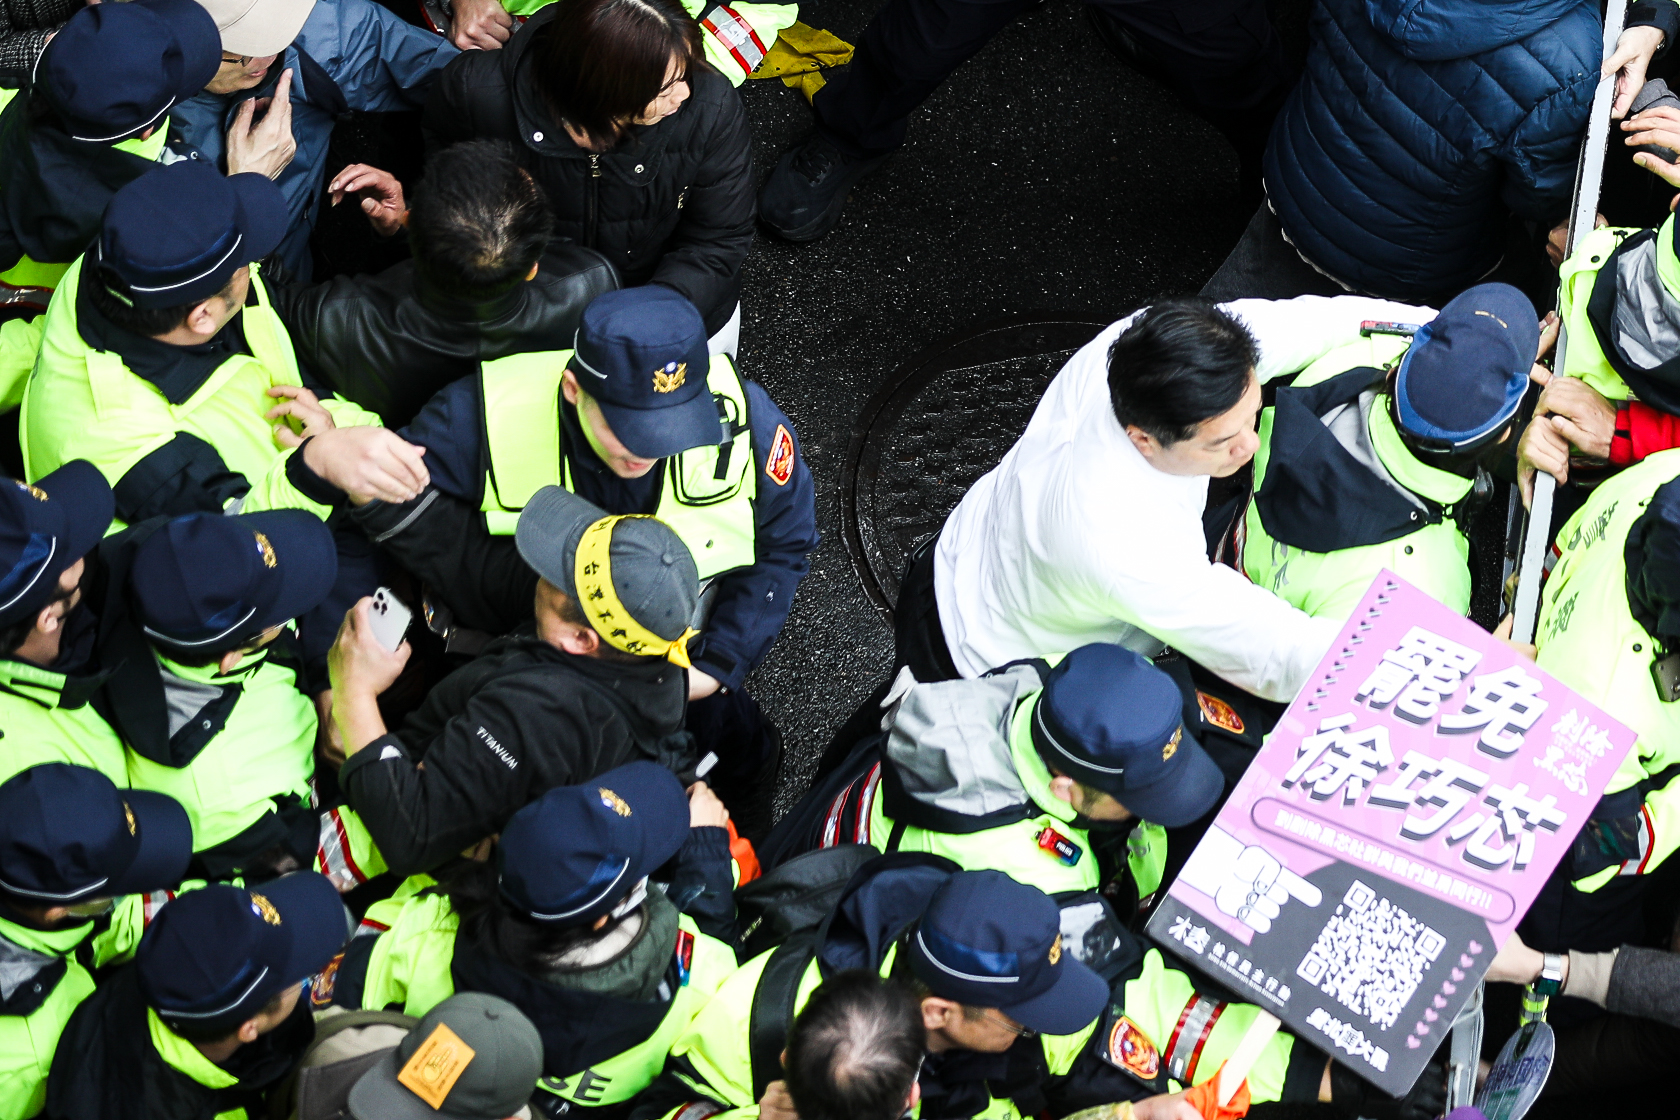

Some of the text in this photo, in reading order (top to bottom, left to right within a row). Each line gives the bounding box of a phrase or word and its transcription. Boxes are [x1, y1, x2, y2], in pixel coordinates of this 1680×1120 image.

[476, 725, 519, 770] TITANIUM
[1353, 625, 1549, 759] 罷免
[1281, 711, 1568, 872] 徐巧芯
